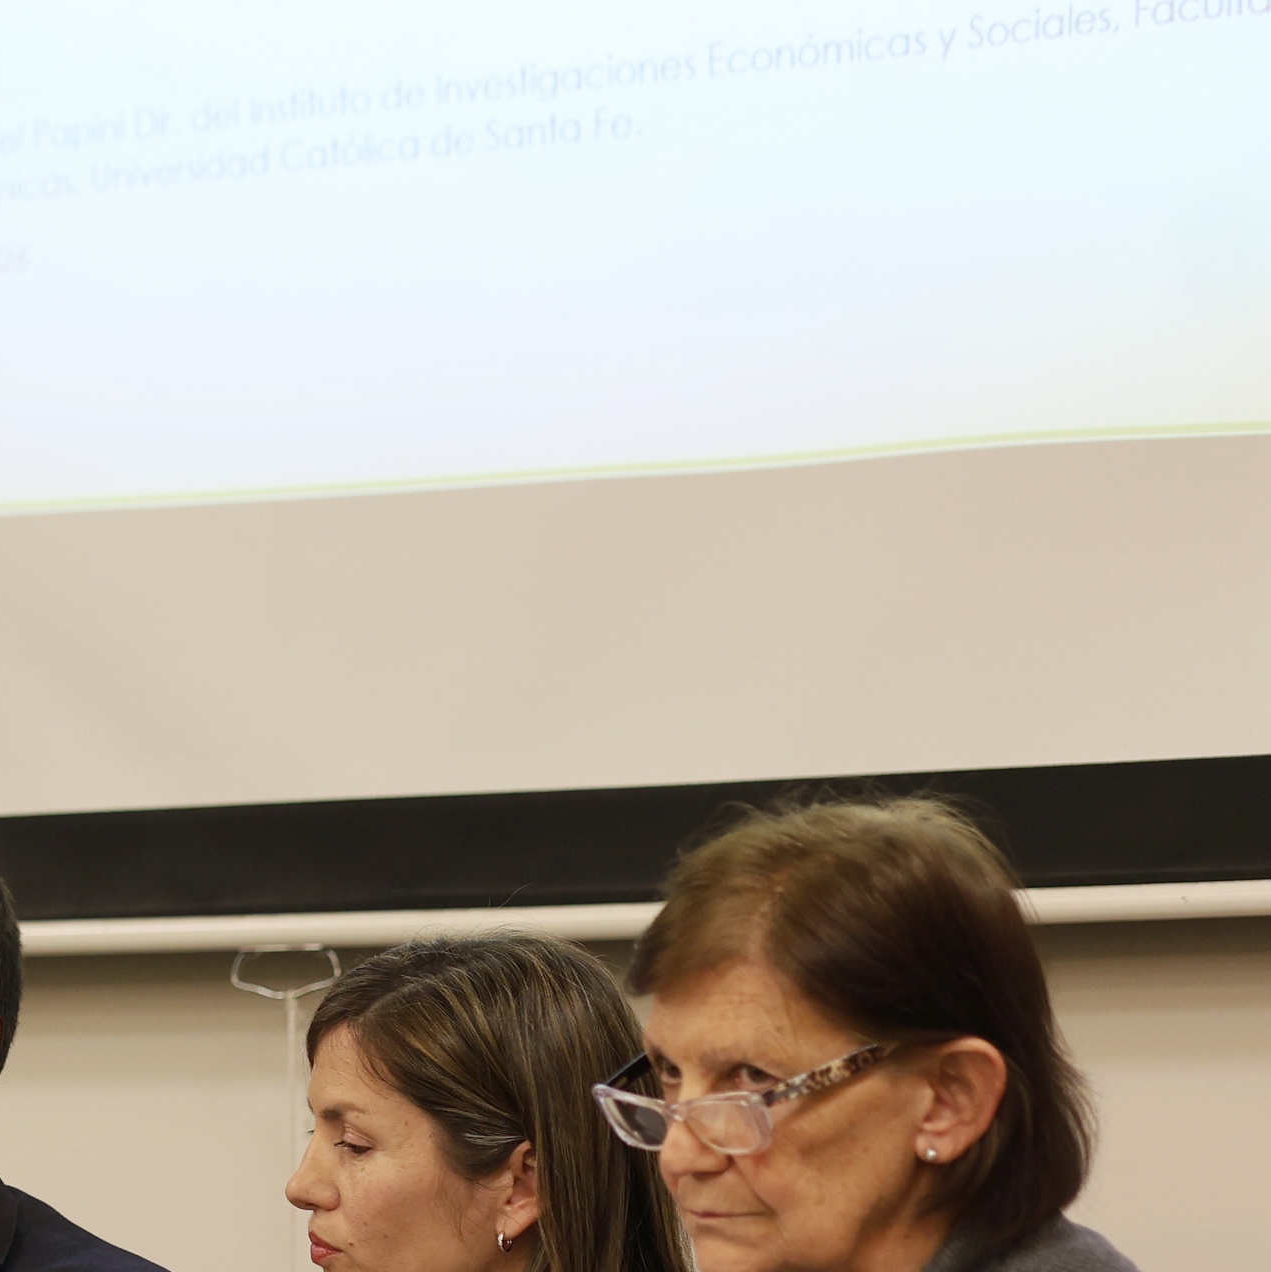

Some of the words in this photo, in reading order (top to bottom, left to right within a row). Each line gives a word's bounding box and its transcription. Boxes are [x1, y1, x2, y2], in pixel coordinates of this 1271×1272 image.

[32, 117, 126, 152] Papini
[191, 98, 241, 132] del
[249, 85, 372, 124] Instituto
[381, 79, 426, 111] de
[435, 54, 698, 103] Investigaciones
[707, 29, 928, 78] Económicas
[937, 28, 957, 59] y
[967, 4, 1121, 50] Sociales,
[91, 148, 271, 193] Universidad
[279, 132, 422, 173] Católica
[430, 125, 475, 157] de
[485, 113, 583, 151] Santa
[593, 106, 644, 140] Fe.
